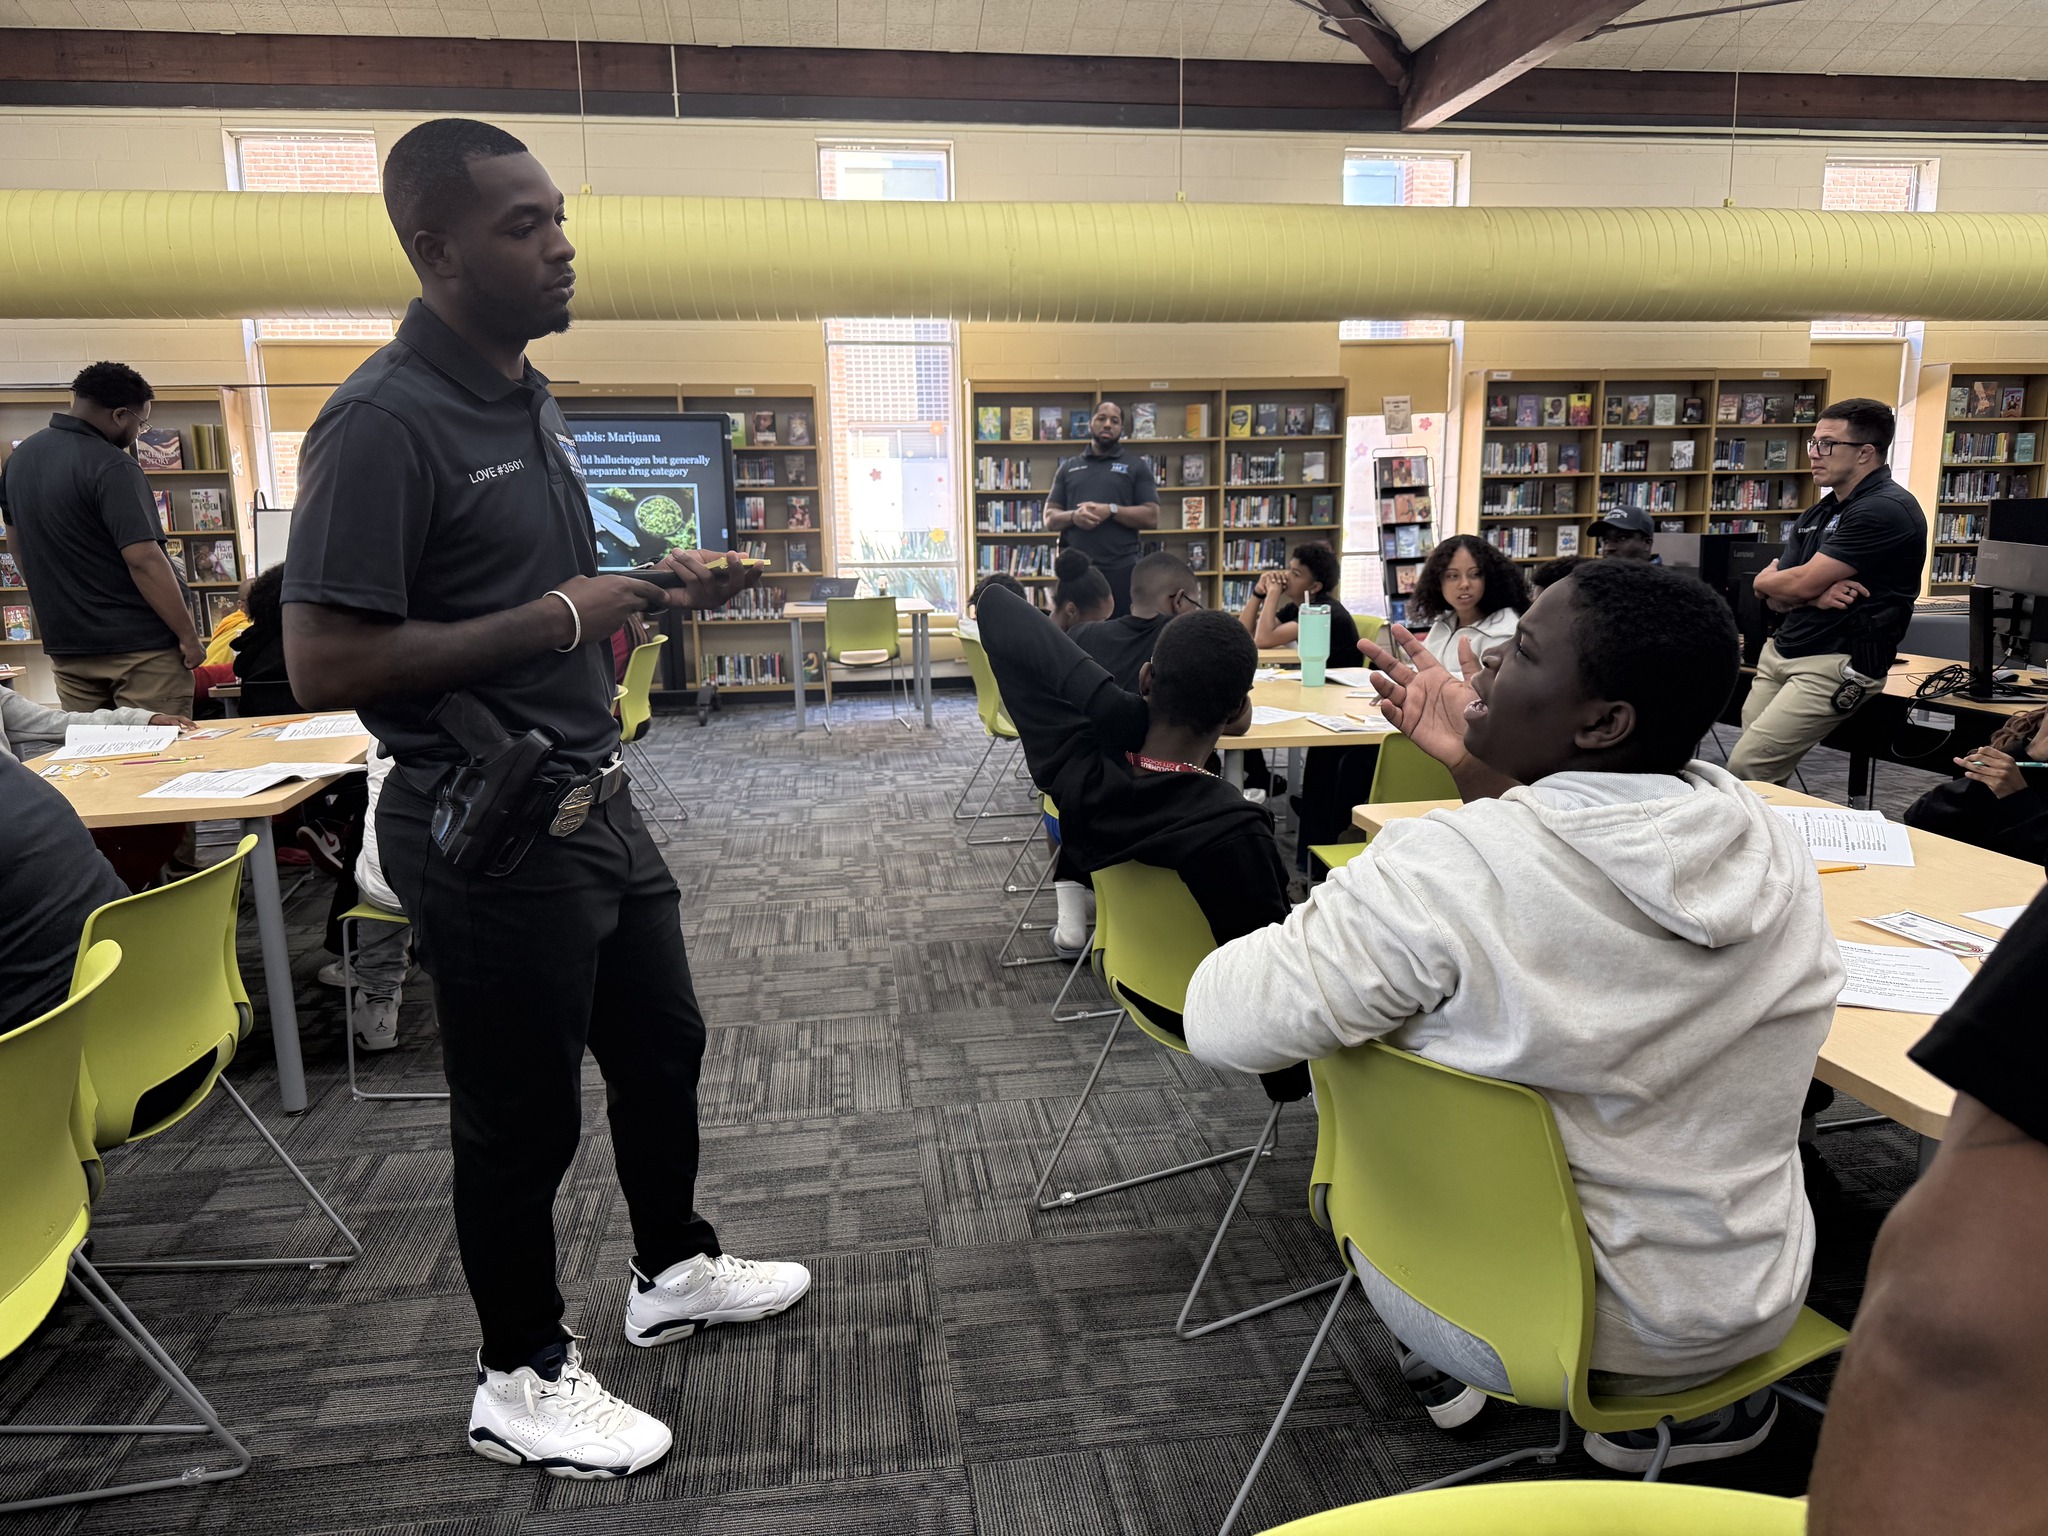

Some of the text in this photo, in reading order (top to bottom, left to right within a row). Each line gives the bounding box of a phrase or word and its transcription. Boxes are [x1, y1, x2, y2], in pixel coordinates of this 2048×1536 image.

[574, 431, 605, 443] nabis:
[608, 431, 661, 444] Marijuana
[581, 455, 711, 467] ild hallucinogen but generally
[468, 458, 525, 484] LOVE #3501
[589, 467, 627, 478] separate
[628, 466, 650, 478] drug
[650, 467, 689, 478] category
[217, 543, 233, 552] Hair
[1733, 550, 1755, 558] Lenovo
